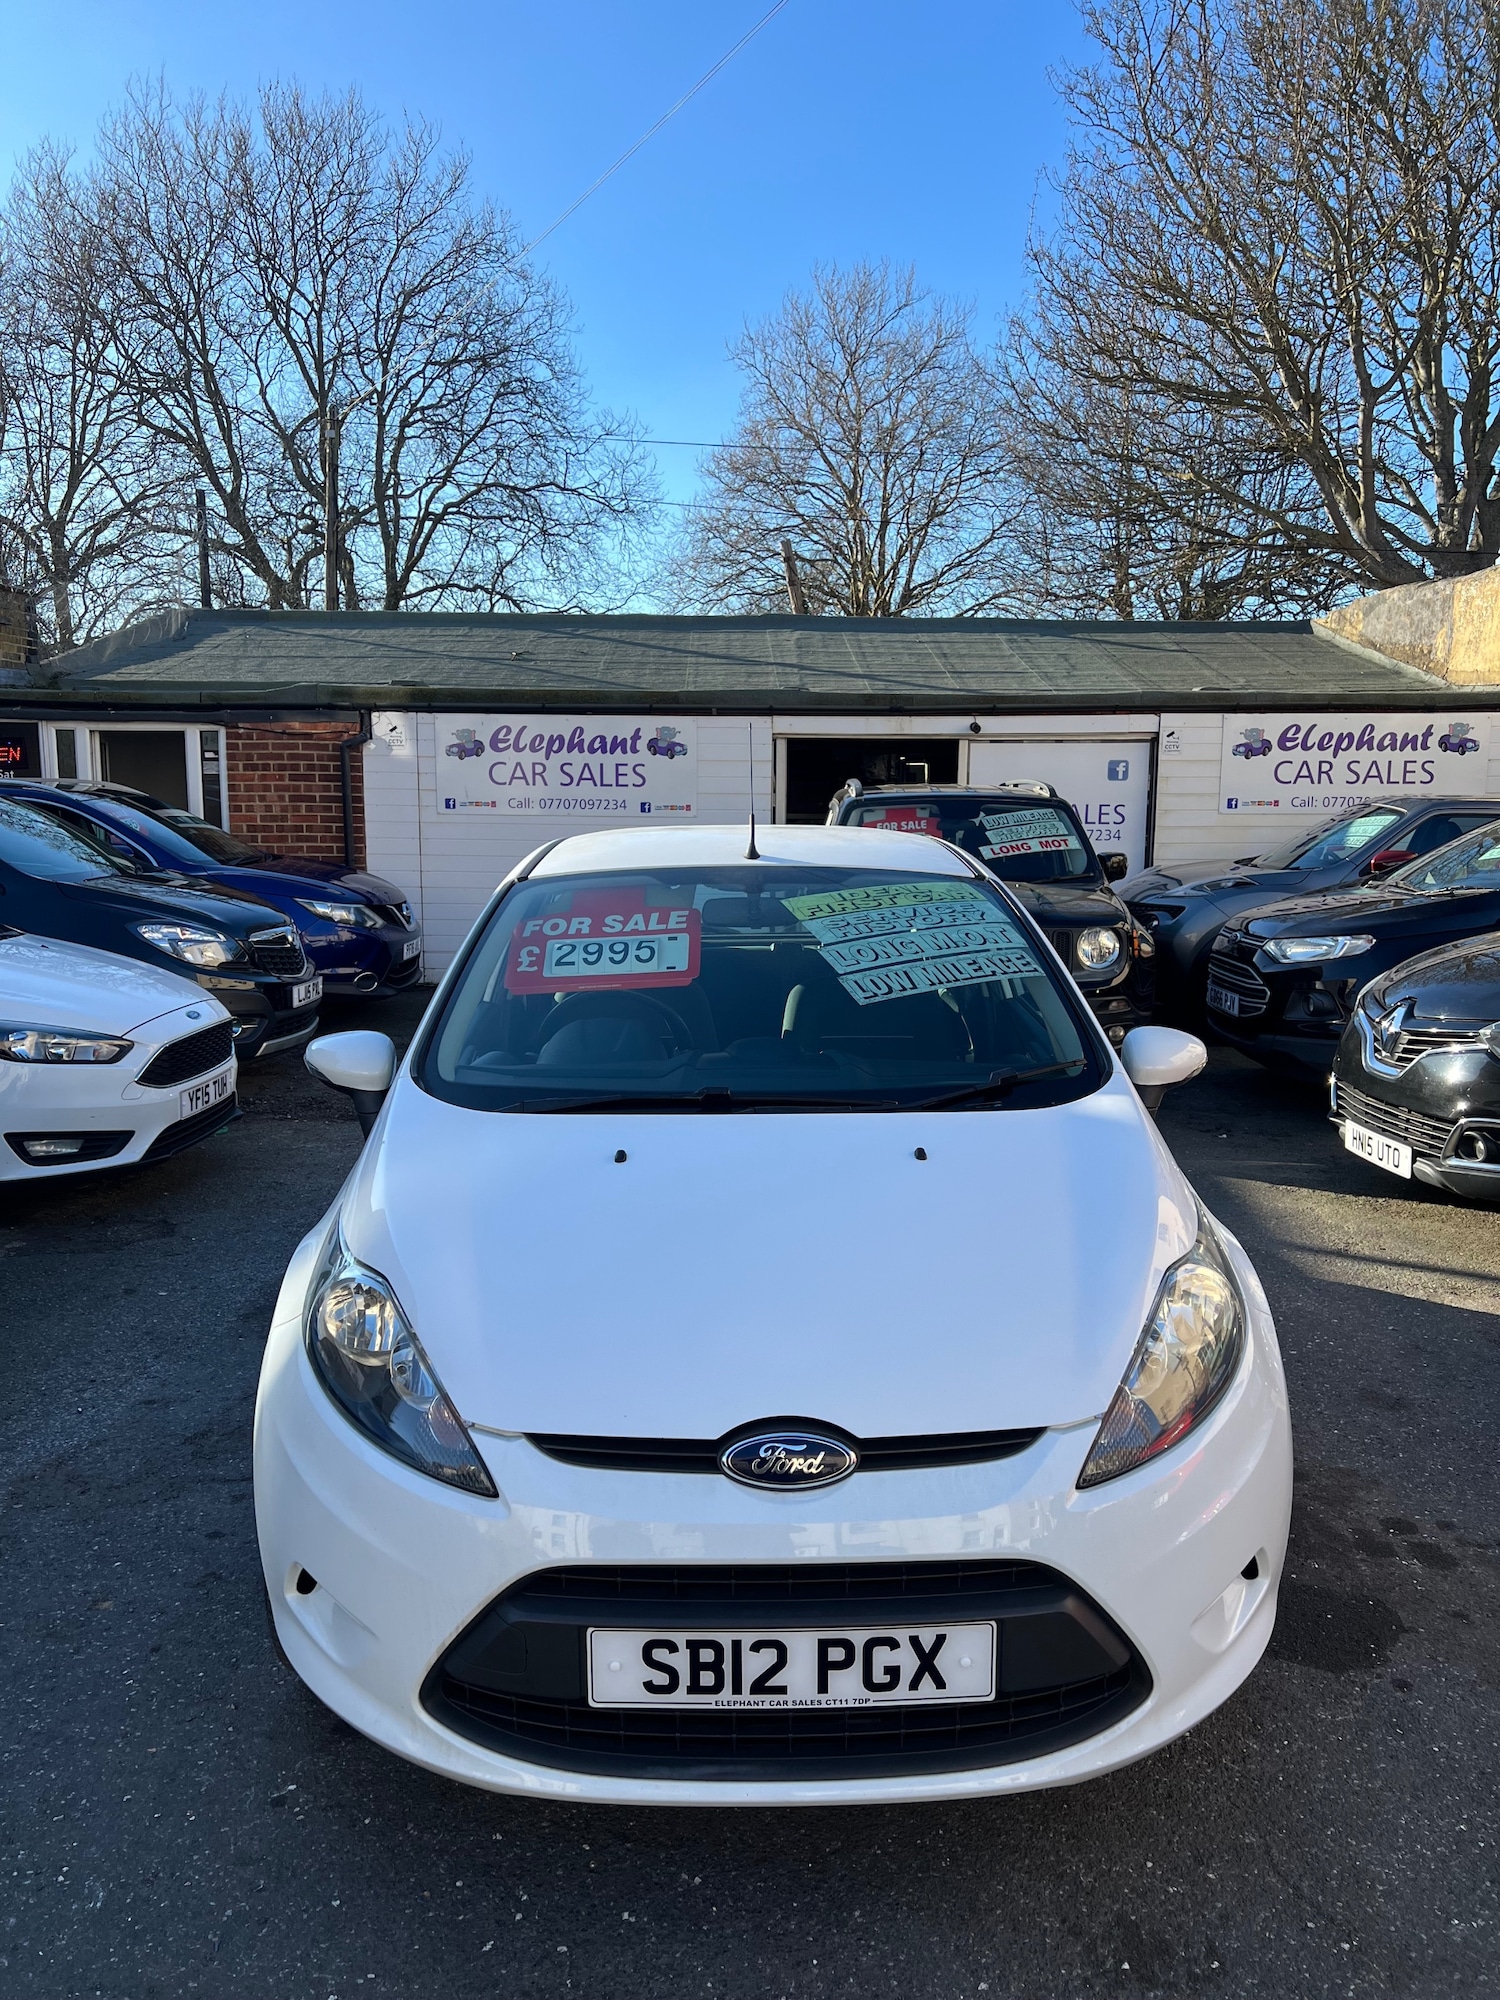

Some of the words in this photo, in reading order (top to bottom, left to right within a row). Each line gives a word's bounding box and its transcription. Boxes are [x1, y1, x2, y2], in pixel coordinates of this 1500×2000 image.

[488, 724, 642, 761] Elephant
[1276, 723, 1434, 759] Elephant
[488, 761, 548, 787] CAR
[559, 762, 647, 788] SALES
[1273, 760, 1334, 785] CAR
[1345, 760, 1435, 785] SALES
[506, 797, 534, 810] Call:
[538, 799, 627, 811] 07707097234
[1291, 796, 1318, 808] Call:
[876, 822, 899, 831] FOR
[900, 820, 927, 831] SALE
[985, 814, 1010, 827] LOW
[1012, 809, 1057, 824] MILEAGE
[990, 842, 1032, 856] LONG
[1038, 839, 1069, 849] MOT
[798, 895, 900, 919] FIRST
[903, 885, 980, 902] CAR
[831, 884, 932, 902] IDEAL
[522, 917, 592, 938] FOR
[602, 910, 690, 934] SALE
[821, 901, 982, 930] SERVICE
[828, 910, 988, 940] HISTORY
[831, 934, 926, 967] LONG
[847, 968, 919, 1000] LOW
[917, 953, 1041, 986] MILEAGE
[188, 1083, 210, 1112] YF15
[213, 1074, 228, 1101] TUH
[1352, 1128, 1373, 1156] HN15
[1377, 1140, 1401, 1169] UTO
[751, 1442, 827, 1475] Ford
[641, 1638, 788, 1696] SB12
[817, 1633, 947, 1695] PGX
[769, 1699, 789, 1707] CAR
[825, 1698, 849, 1706] CT11
[852, 1697, 871, 1705] 7DP
